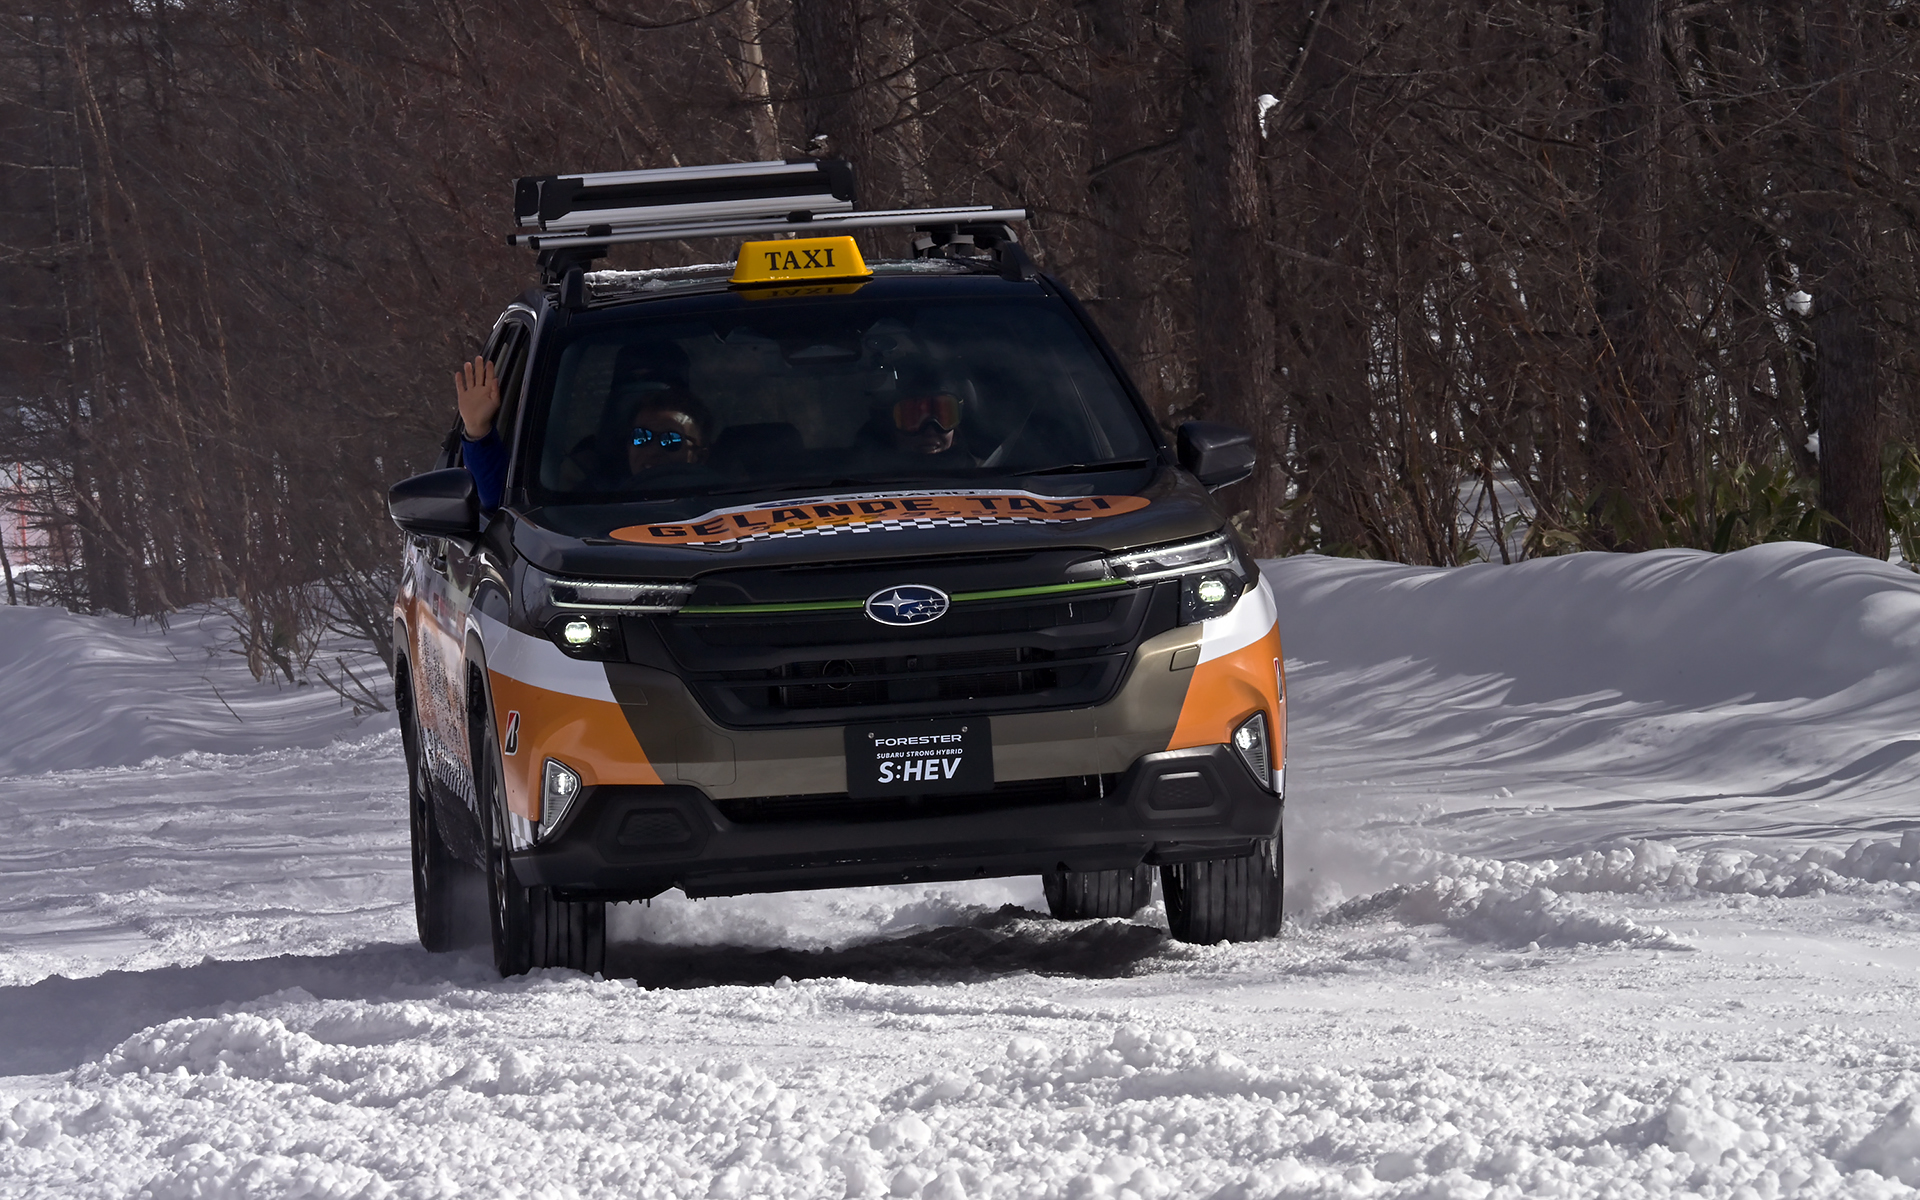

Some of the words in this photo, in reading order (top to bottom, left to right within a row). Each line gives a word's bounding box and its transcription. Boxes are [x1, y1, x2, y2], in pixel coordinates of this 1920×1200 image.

[764, 248, 835, 271] TAXI
[648, 498, 940, 537] GELANDE
[965, 497, 1112, 514] TAXI
[875, 734, 962, 747] FORESTER
[876, 751, 905, 759] SUBARU
[906, 749, 935, 757] STRONG
[936, 748, 963, 756] HYBRID
[878, 757, 962, 784] S:HEV
